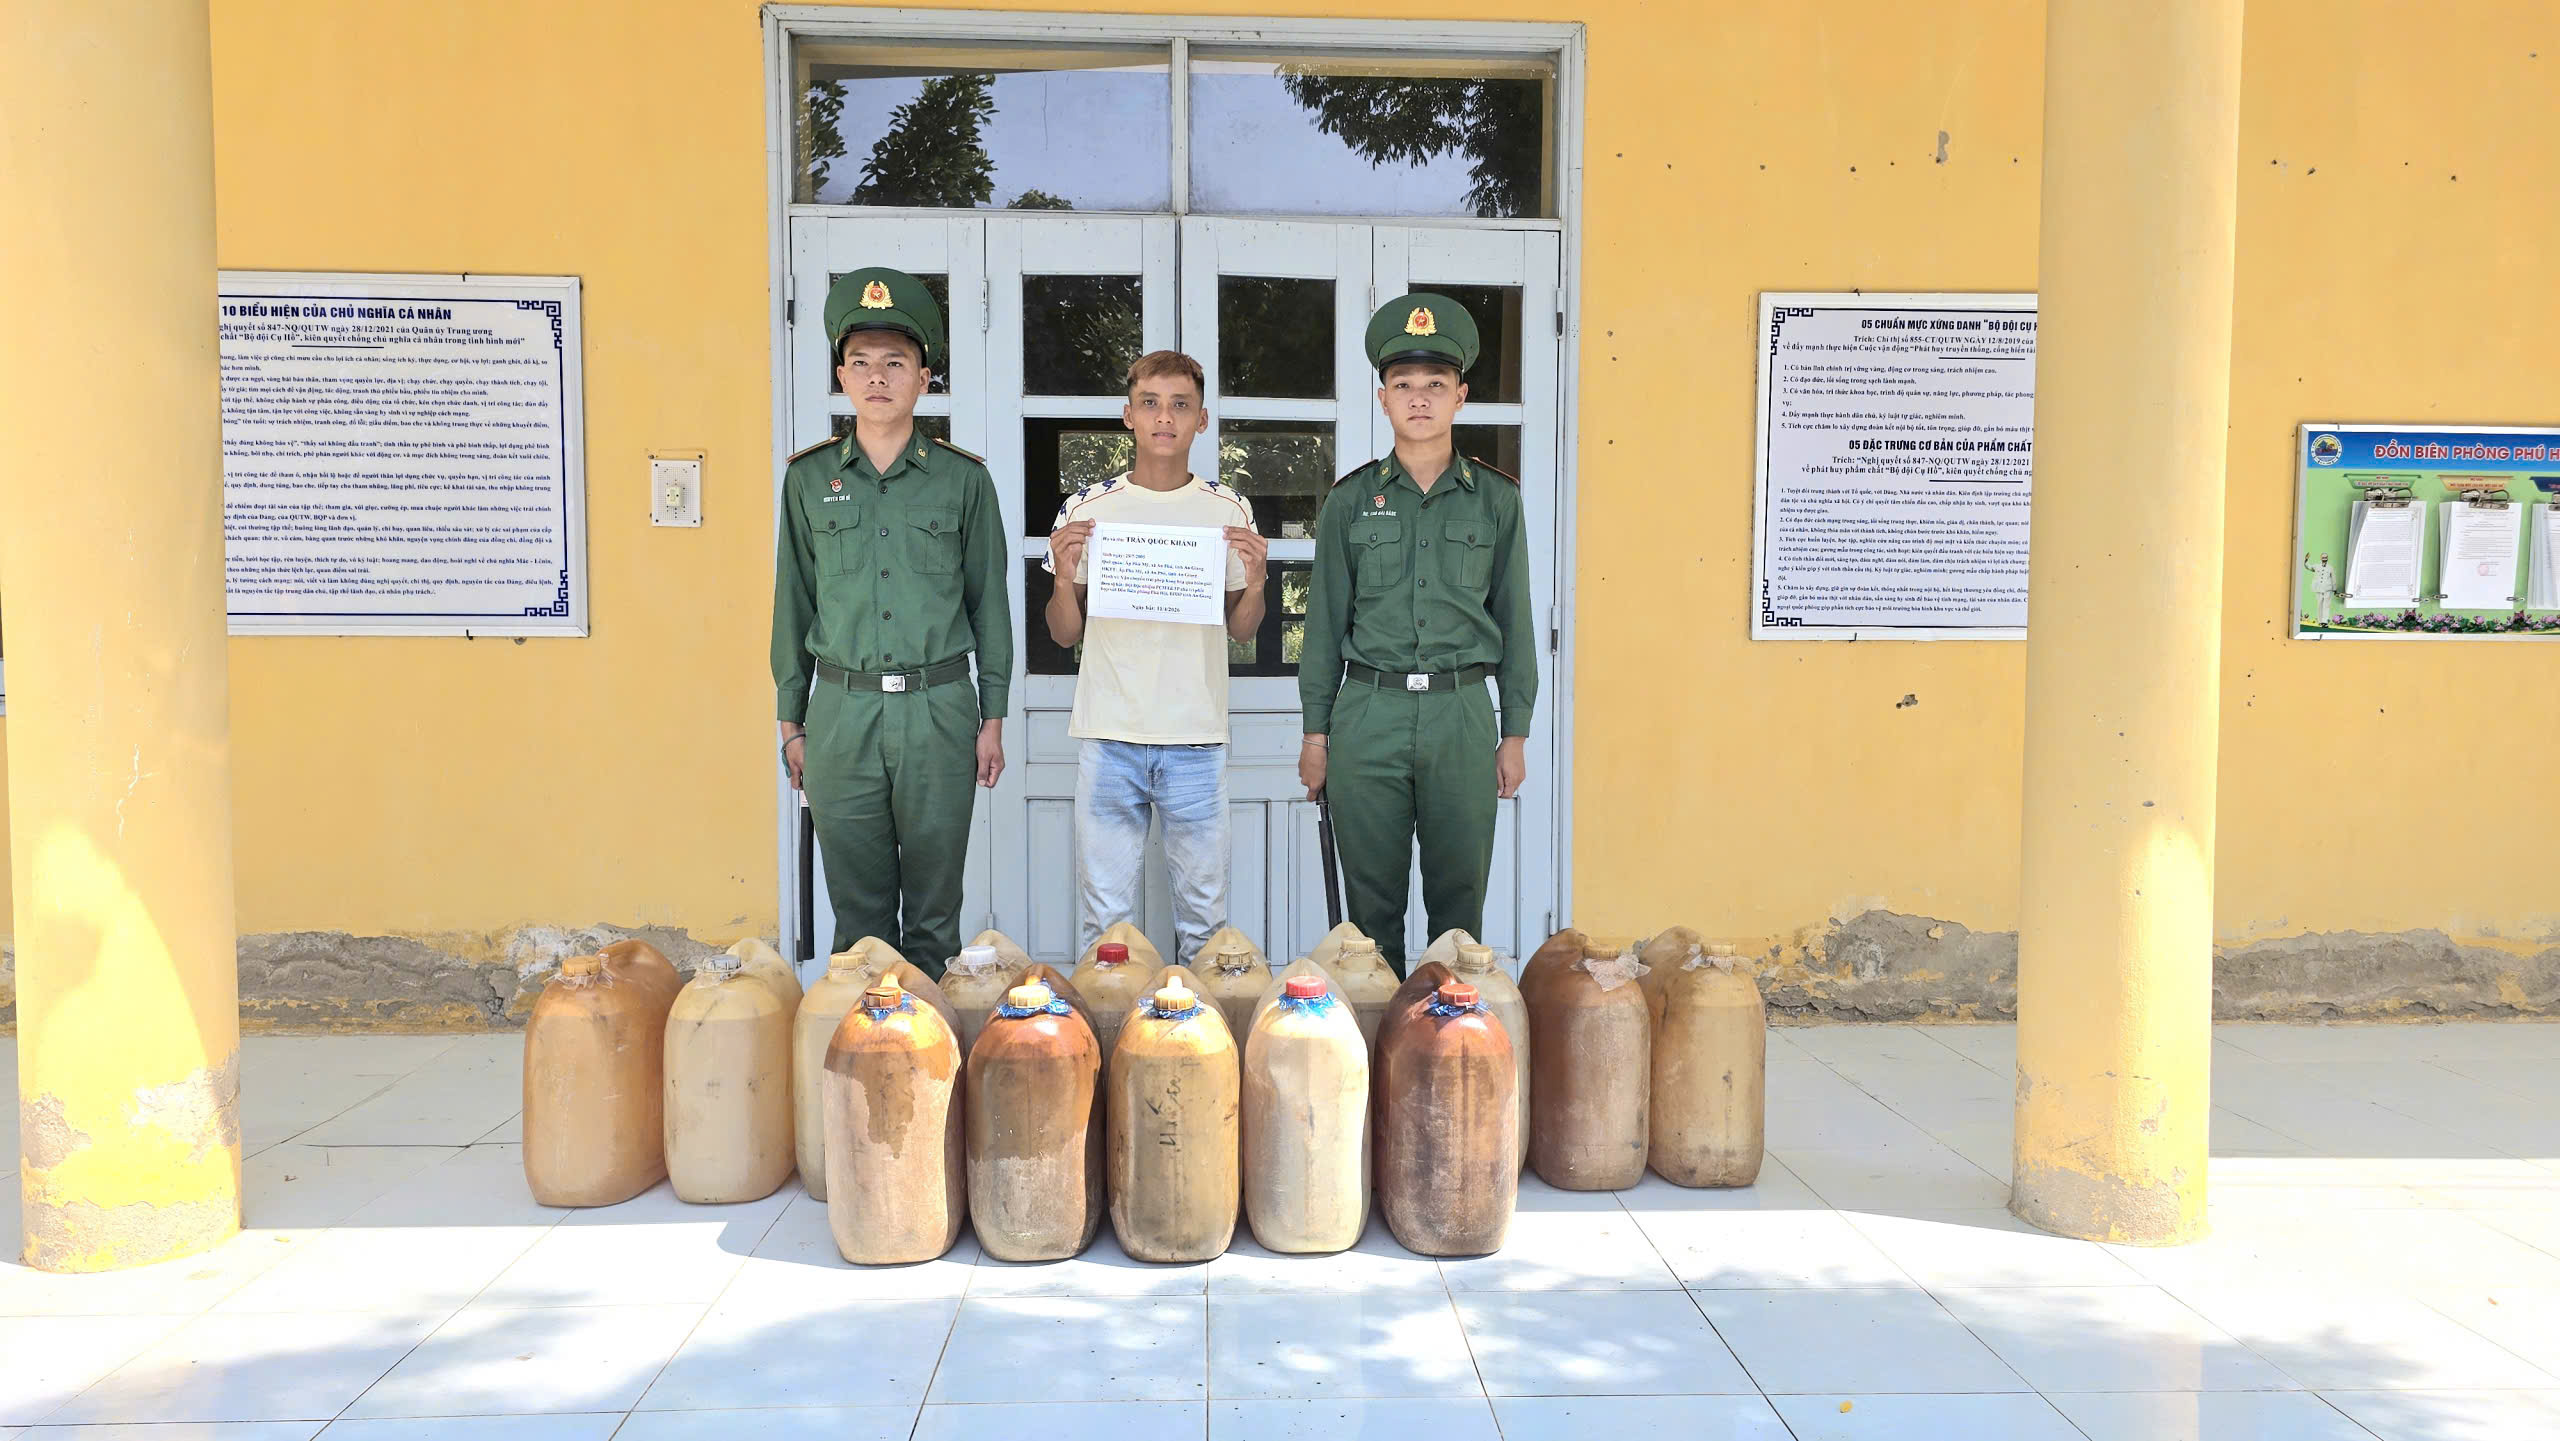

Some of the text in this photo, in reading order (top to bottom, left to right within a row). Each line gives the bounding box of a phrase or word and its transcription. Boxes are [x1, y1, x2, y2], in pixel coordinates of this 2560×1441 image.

[222, 302, 451, 320] 10 BIỂU HIỆN CỦA CHỦ NGHĨA CÁ NHÂN
[219, 324, 233, 334] ghị
[1862, 320, 1872, 328] 05
[1875, 316, 1905, 329] CHUẨN
[1908, 320, 1927, 331] MỰC
[1930, 319, 1954, 330] XỨNG
[1957, 321, 1981, 330] DANH
[2003, 320, 2017, 332] ĐỘI
[2020, 322, 2032, 332] CỤ
[220, 333, 237, 341] chất
[256, 334, 268, 342] đội
[271, 334, 281, 342] Cụ
[324, 335, 345, 343] quyết
[348, 335, 371, 343] chống
[389, 336, 411, 344] nghĩa
[1849, 439, 2032, 452] 05 ĐẶC TRƯNG CƠ BẢN CỦA PHẨM CHẤT
[2375, 440, 2410, 459] ĐỒN
[2414, 443, 2448, 459] BIÊN
[2453, 443, 2509, 460] PHÒNG
[2514, 445, 2544, 460] PHÚ
